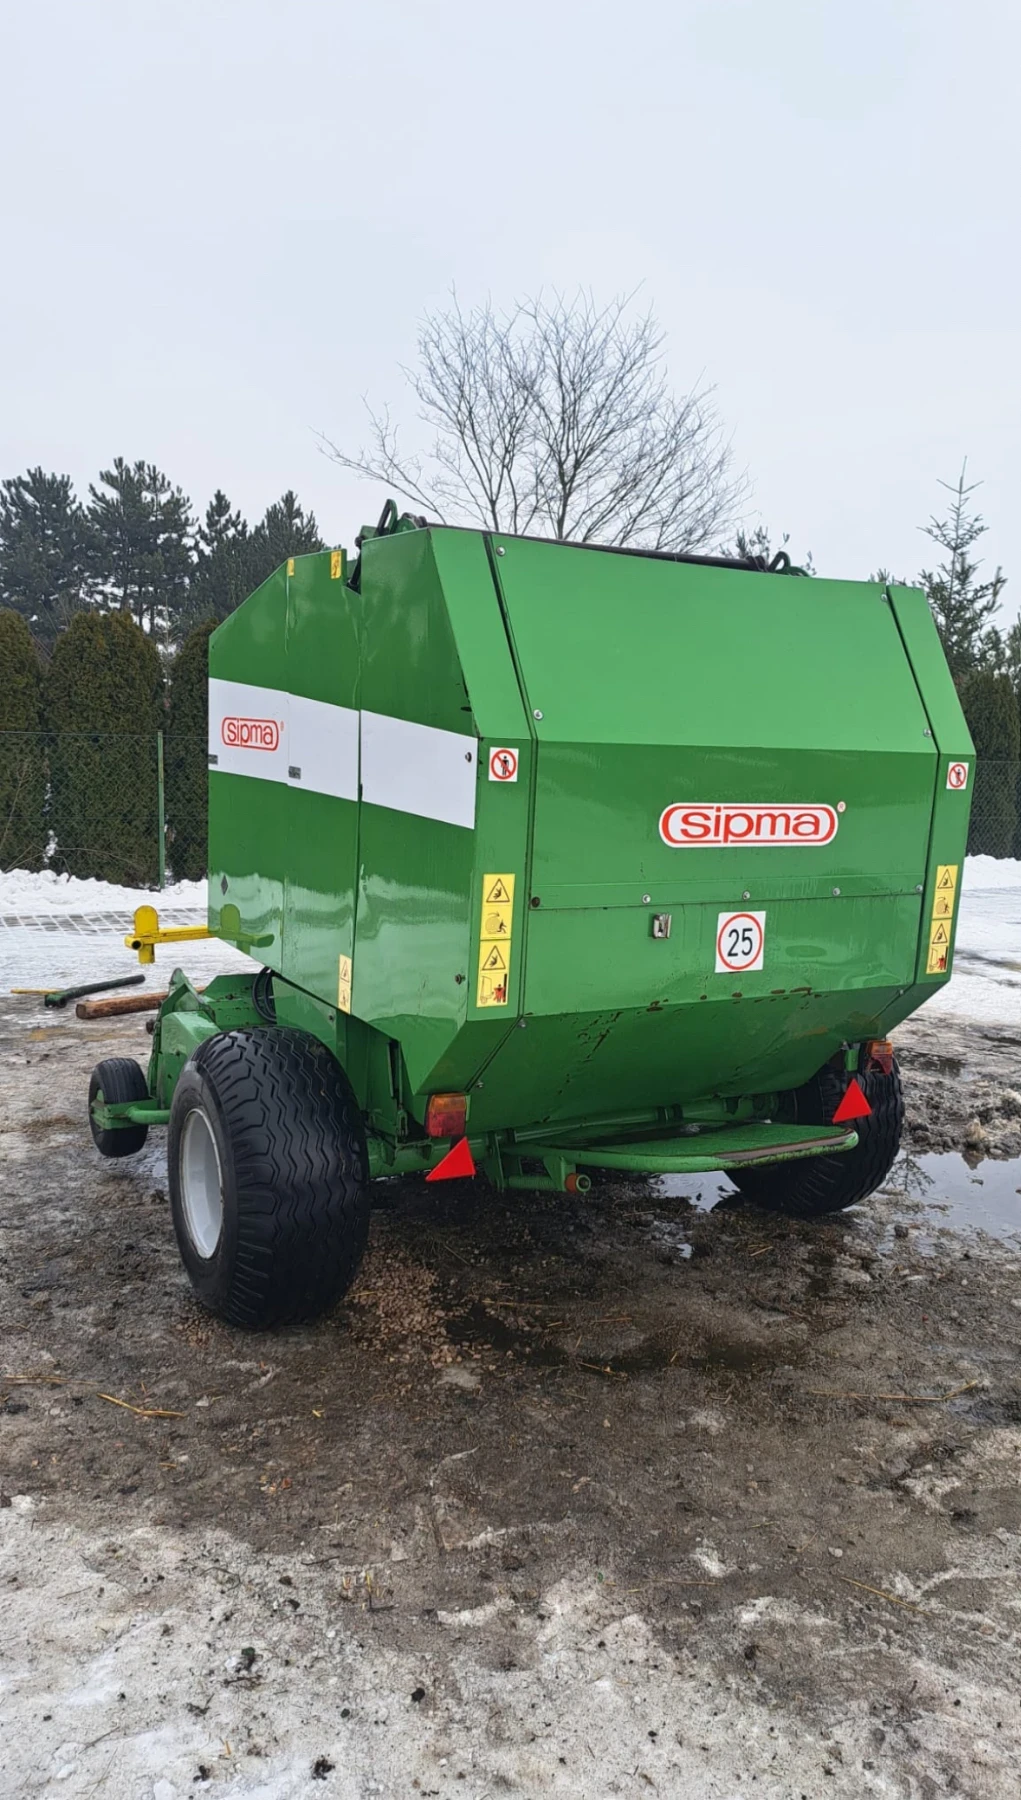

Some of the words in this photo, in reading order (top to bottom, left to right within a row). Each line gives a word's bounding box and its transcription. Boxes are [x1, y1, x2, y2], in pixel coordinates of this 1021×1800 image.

[227, 719, 273, 746] sipma
[680, 806, 820, 843] sipma
[727, 928, 753, 957] 25
